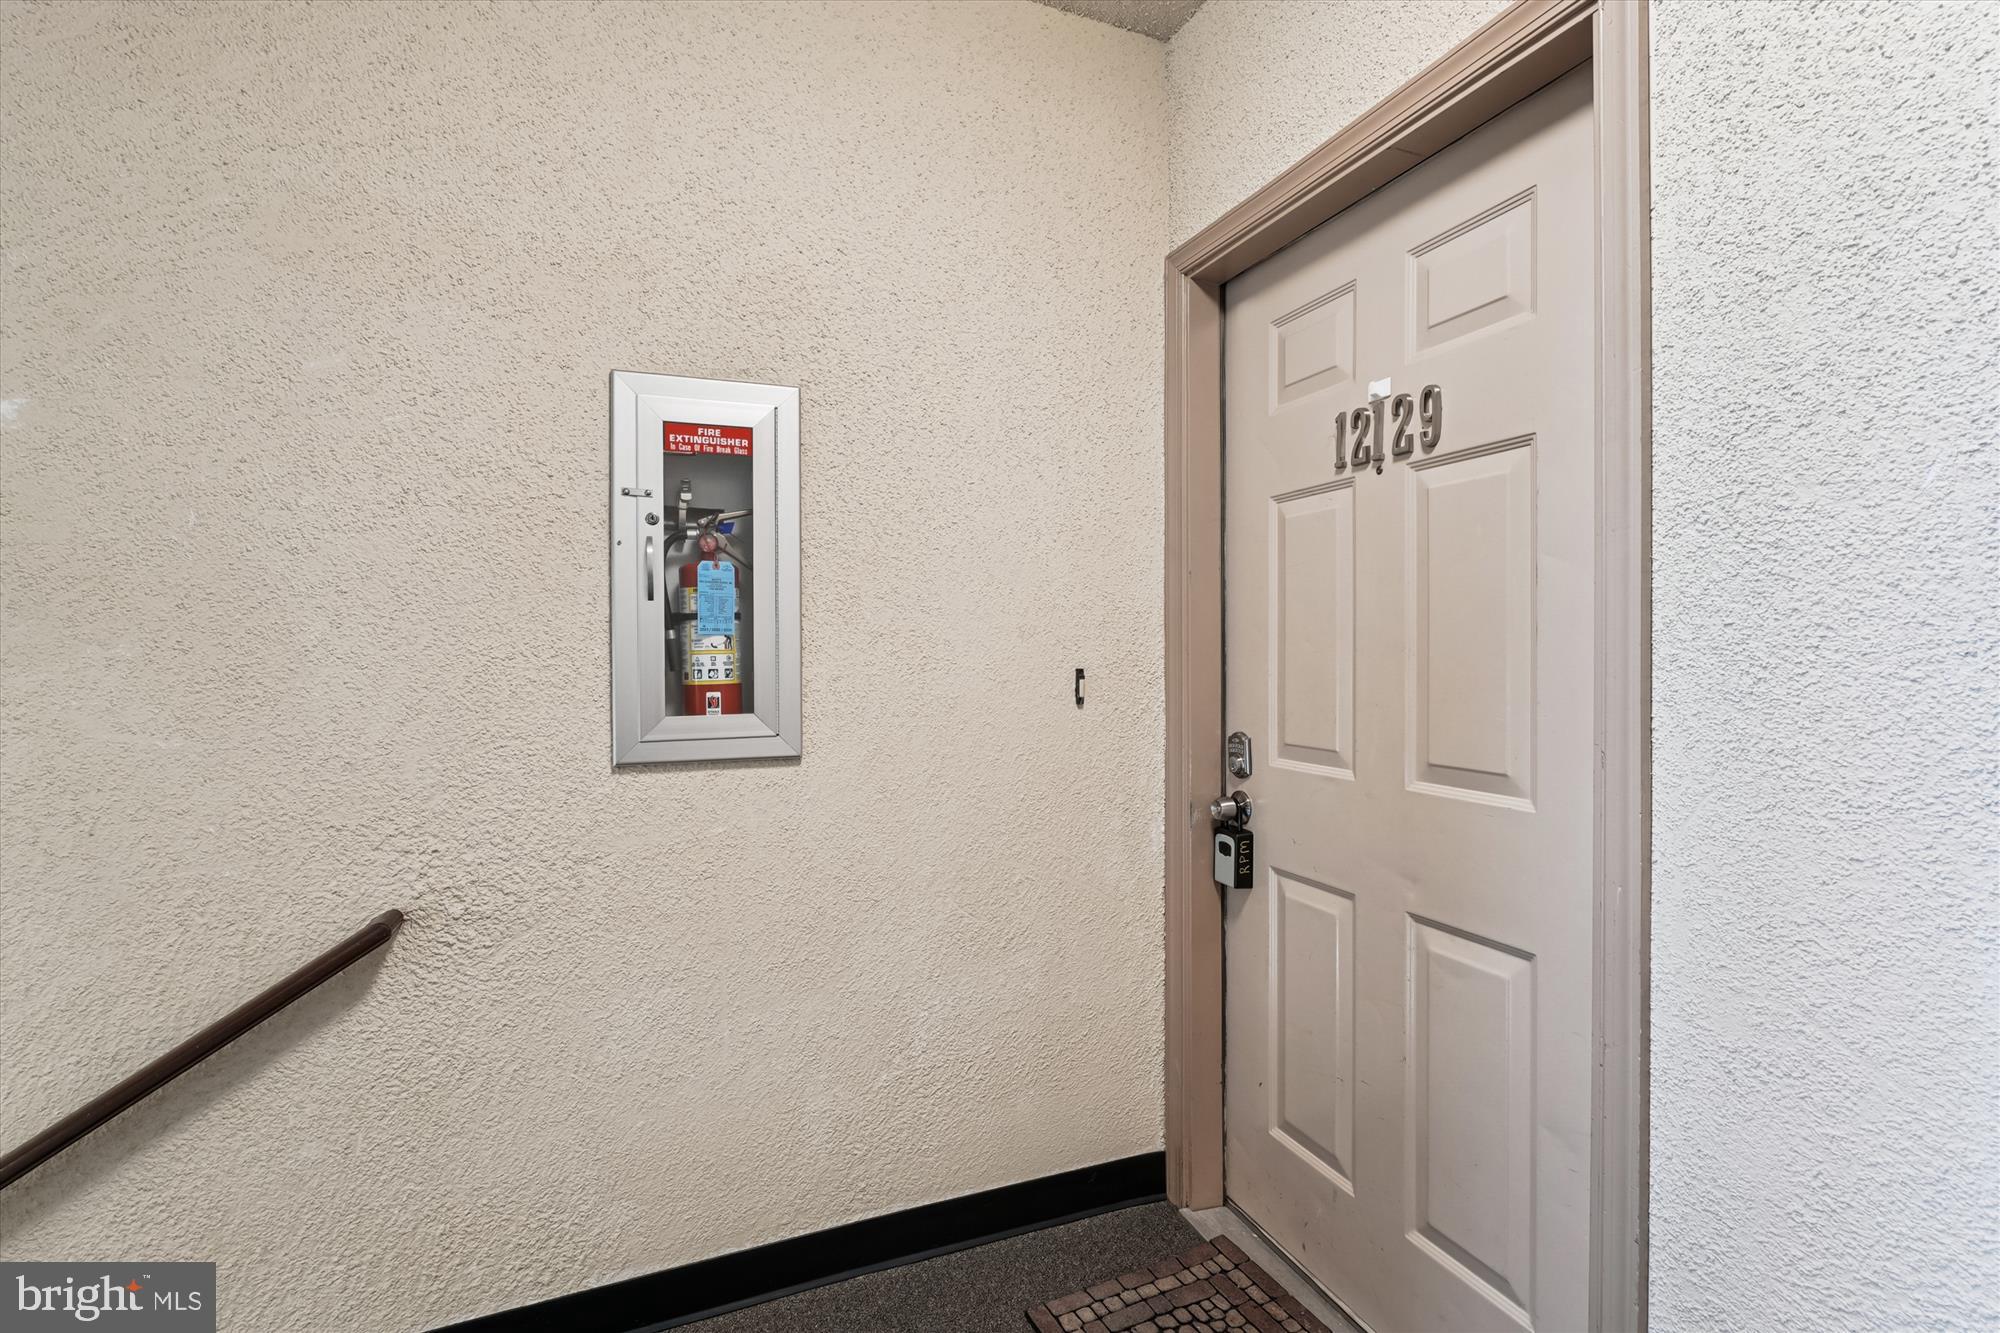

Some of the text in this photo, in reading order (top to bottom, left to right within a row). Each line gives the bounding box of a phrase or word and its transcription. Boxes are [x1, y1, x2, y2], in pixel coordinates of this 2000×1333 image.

[697, 428, 721, 437] FIRE
[1334, 384, 1443, 469] 12129
[669, 434, 749, 447] EXTINGUISHER
[678, 443, 691, 451] Case
[703, 445, 714, 453] Fire
[716, 446, 731, 454] Break
[733, 447, 748, 455] Glass
